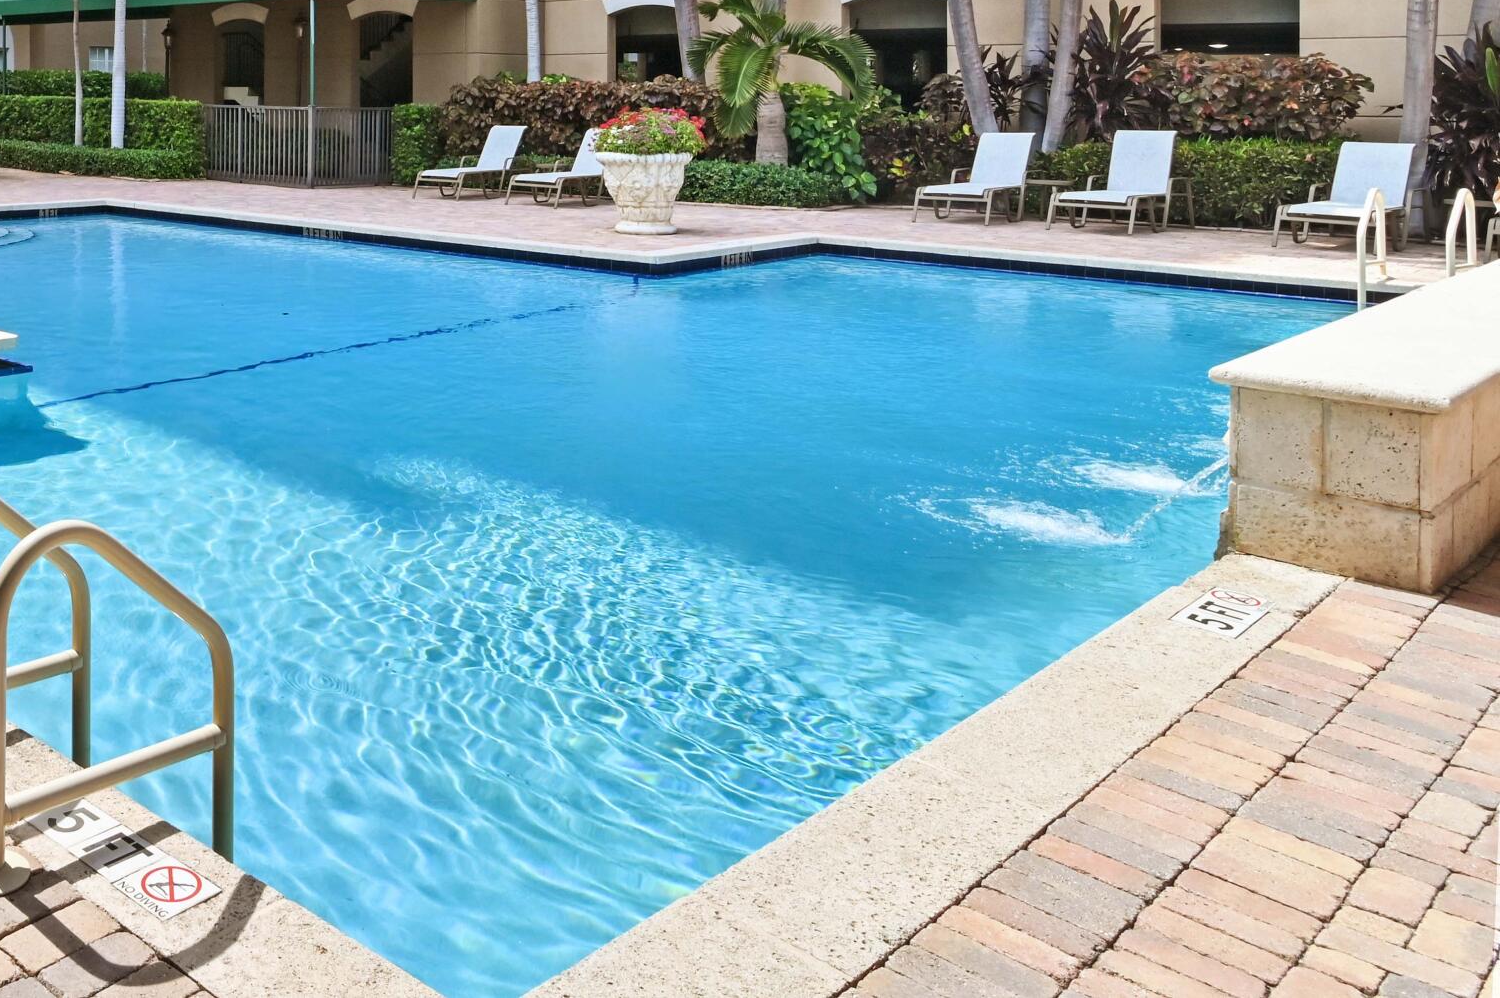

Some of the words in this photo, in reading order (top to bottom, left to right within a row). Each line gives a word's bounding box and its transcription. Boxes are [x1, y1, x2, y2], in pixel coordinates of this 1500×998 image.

[1187, 613, 1235, 631] 5
[1198, 600, 1252, 621] FT
[47, 807, 101, 833] 5
[82, 832, 155, 869] FT
[119, 881, 136, 894] NO
[133, 892, 170, 918] DIVING
